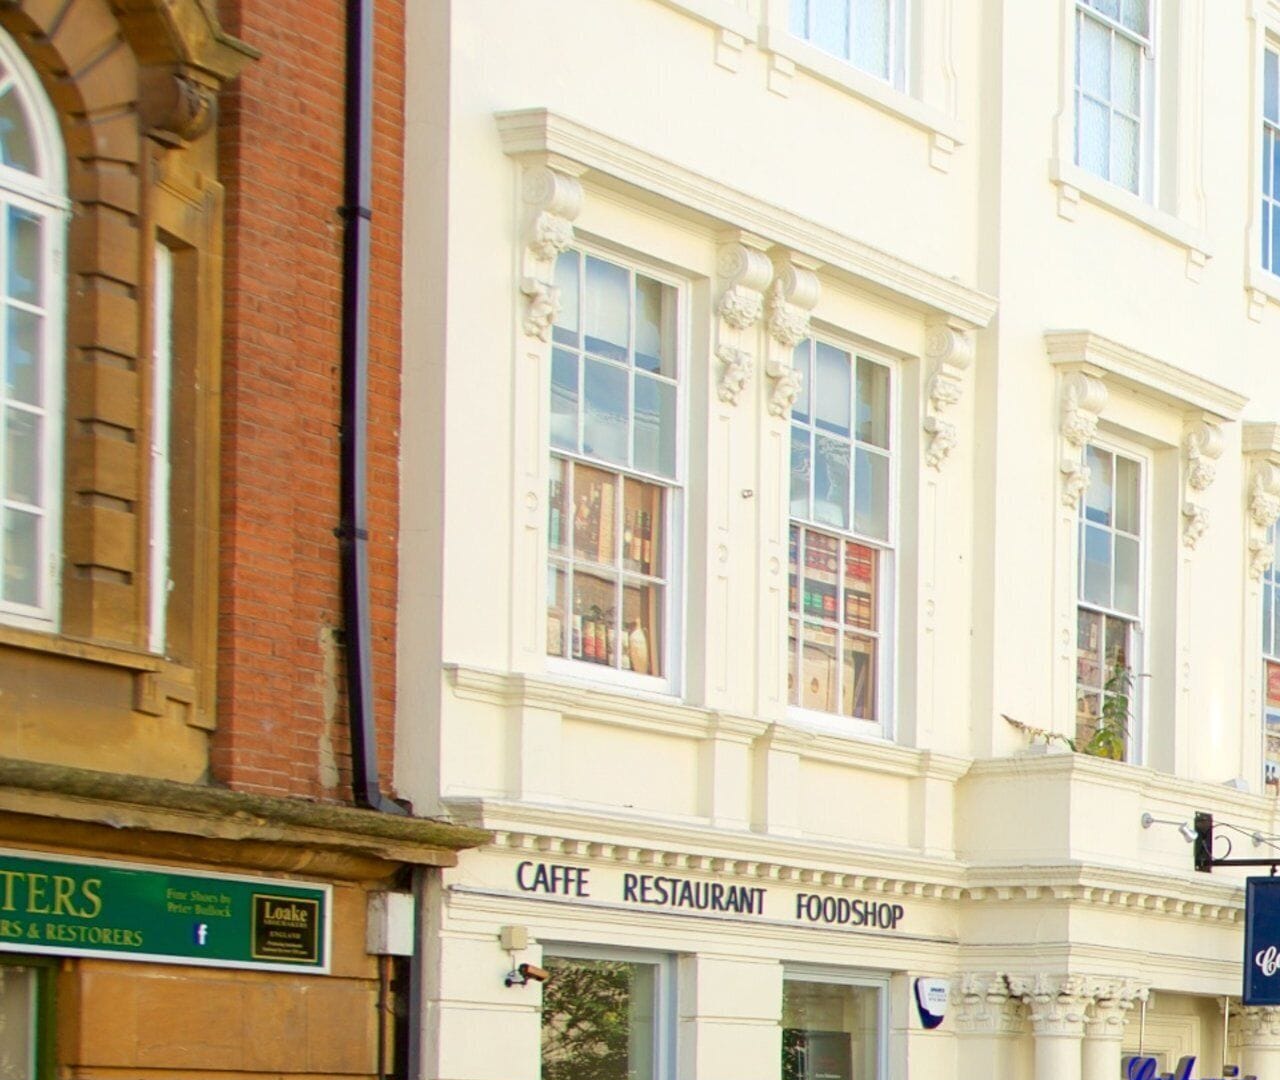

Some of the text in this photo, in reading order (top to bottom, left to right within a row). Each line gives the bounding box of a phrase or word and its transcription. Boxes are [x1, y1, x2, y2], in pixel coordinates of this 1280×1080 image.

[517, 861, 904, 929] CAFFE RESTAURANT FOODSHOP
[264, 901, 308, 922] Loake
[26, 922, 40, 939] &
[45, 923, 144, 947] RESTORERS
